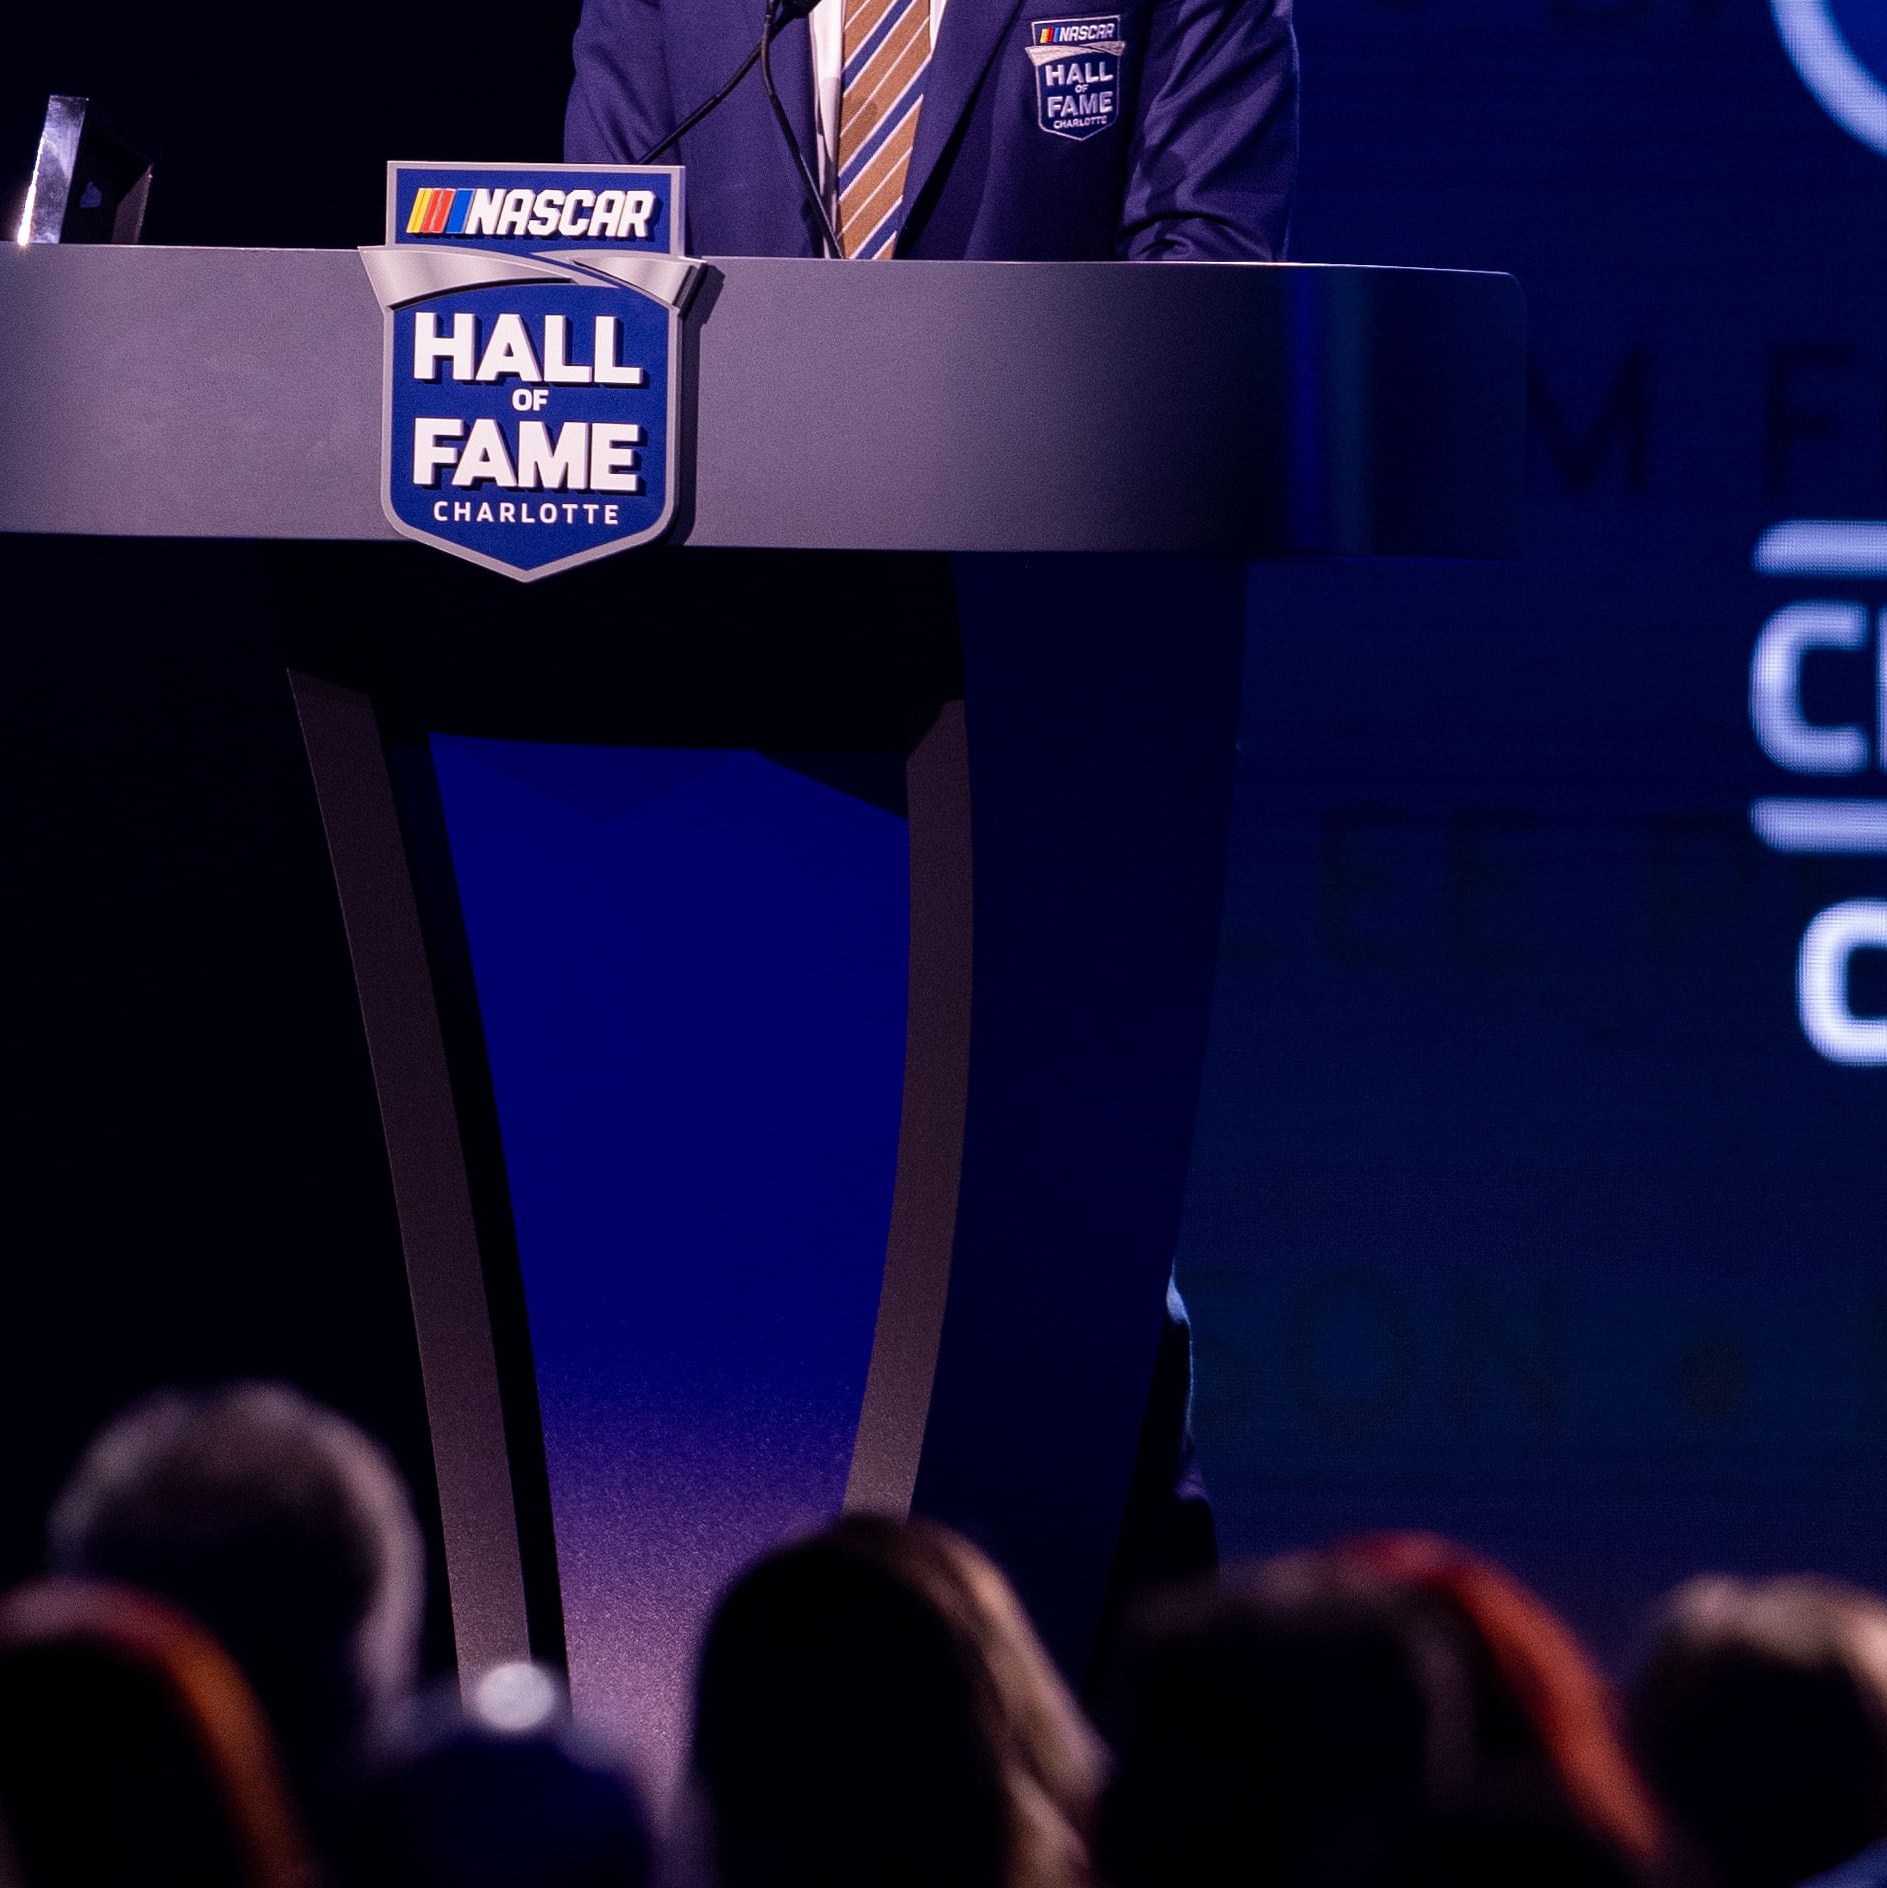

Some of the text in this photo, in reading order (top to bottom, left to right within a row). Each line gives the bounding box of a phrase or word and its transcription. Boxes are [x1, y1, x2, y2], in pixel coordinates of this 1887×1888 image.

[1058, 23, 1115, 42] NASCAR
[1044, 61, 1114, 86] HALL
[1074, 84, 1090, 94] OF
[1047, 90, 1114, 118] FAME
[1053, 115, 1108, 130] CHARLOTTE
[464, 188, 657, 239] NASCAR
[413, 311, 644, 385] HALL
[512, 388, 550, 413] OF
[413, 417, 641, 492] FAME
[433, 500, 620, 525] CHARLOTTE
